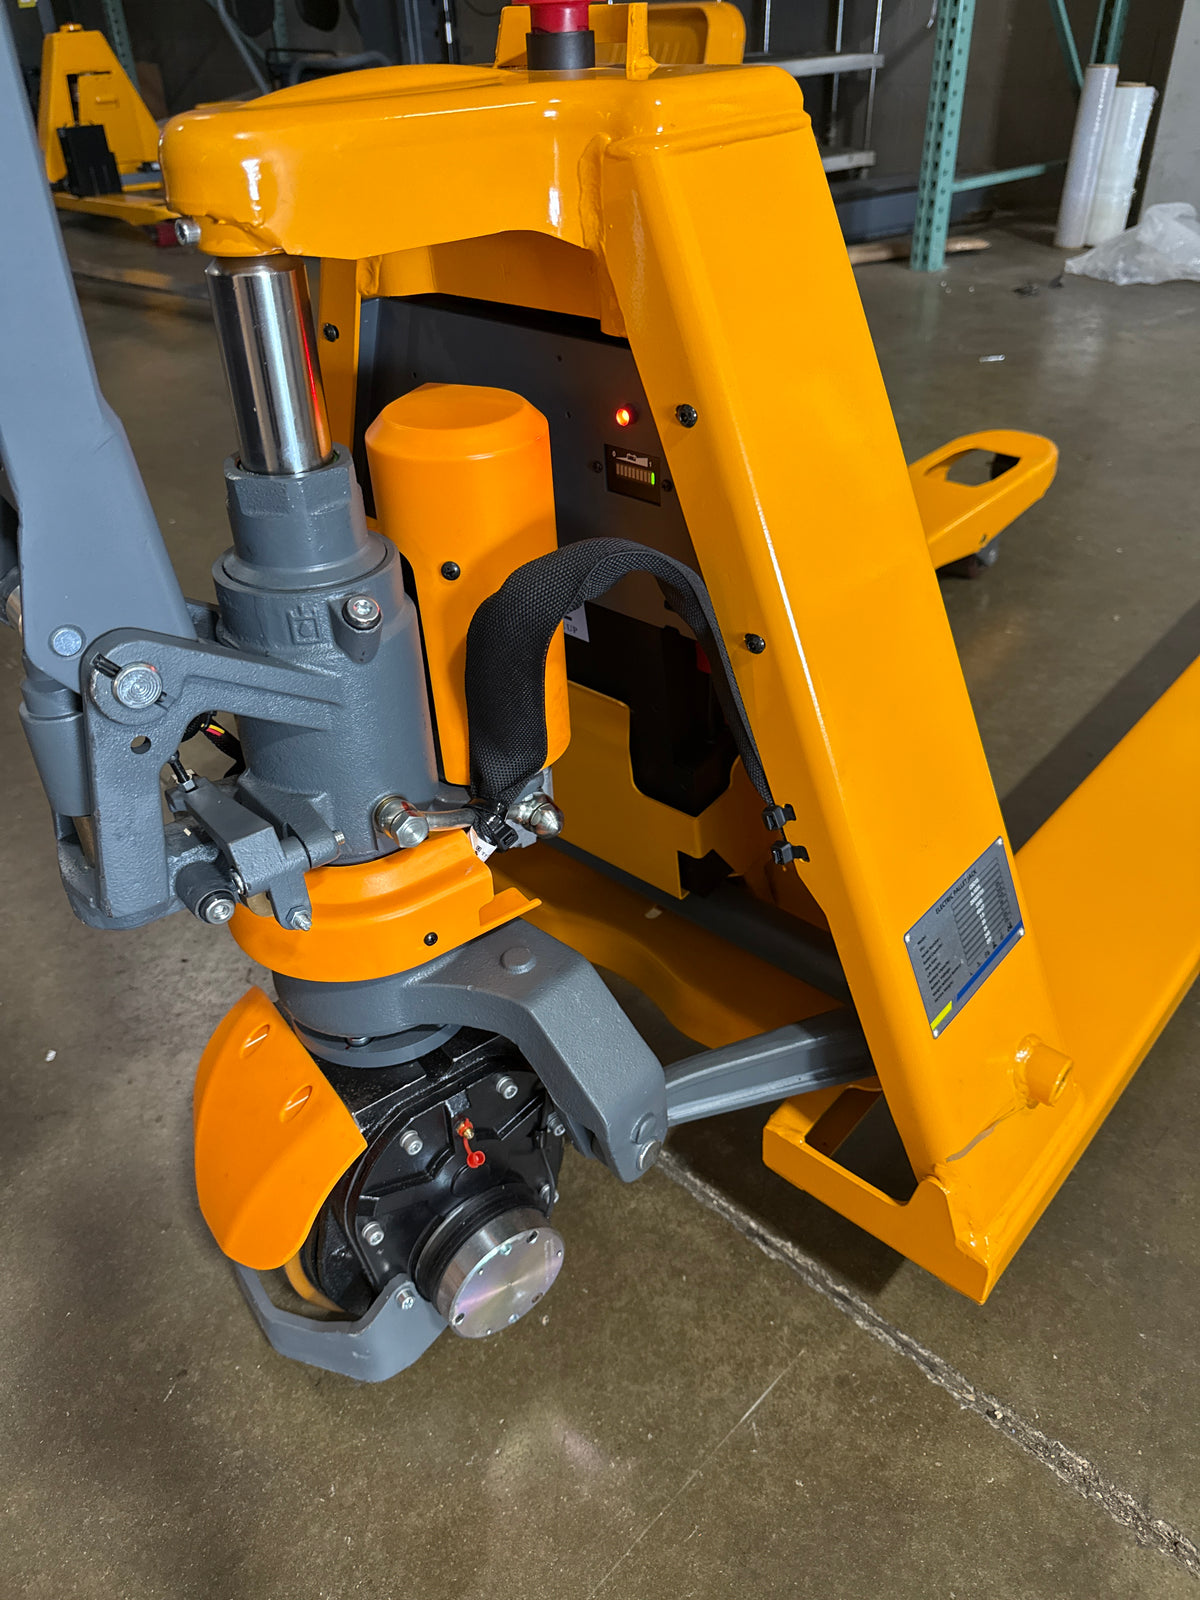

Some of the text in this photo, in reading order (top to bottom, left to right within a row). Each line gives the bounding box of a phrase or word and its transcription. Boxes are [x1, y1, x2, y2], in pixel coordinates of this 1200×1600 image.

[935, 893, 954, 914] ELECTRIC
[953, 878, 968, 896] PALLET
[966, 869, 977, 883] JACK
